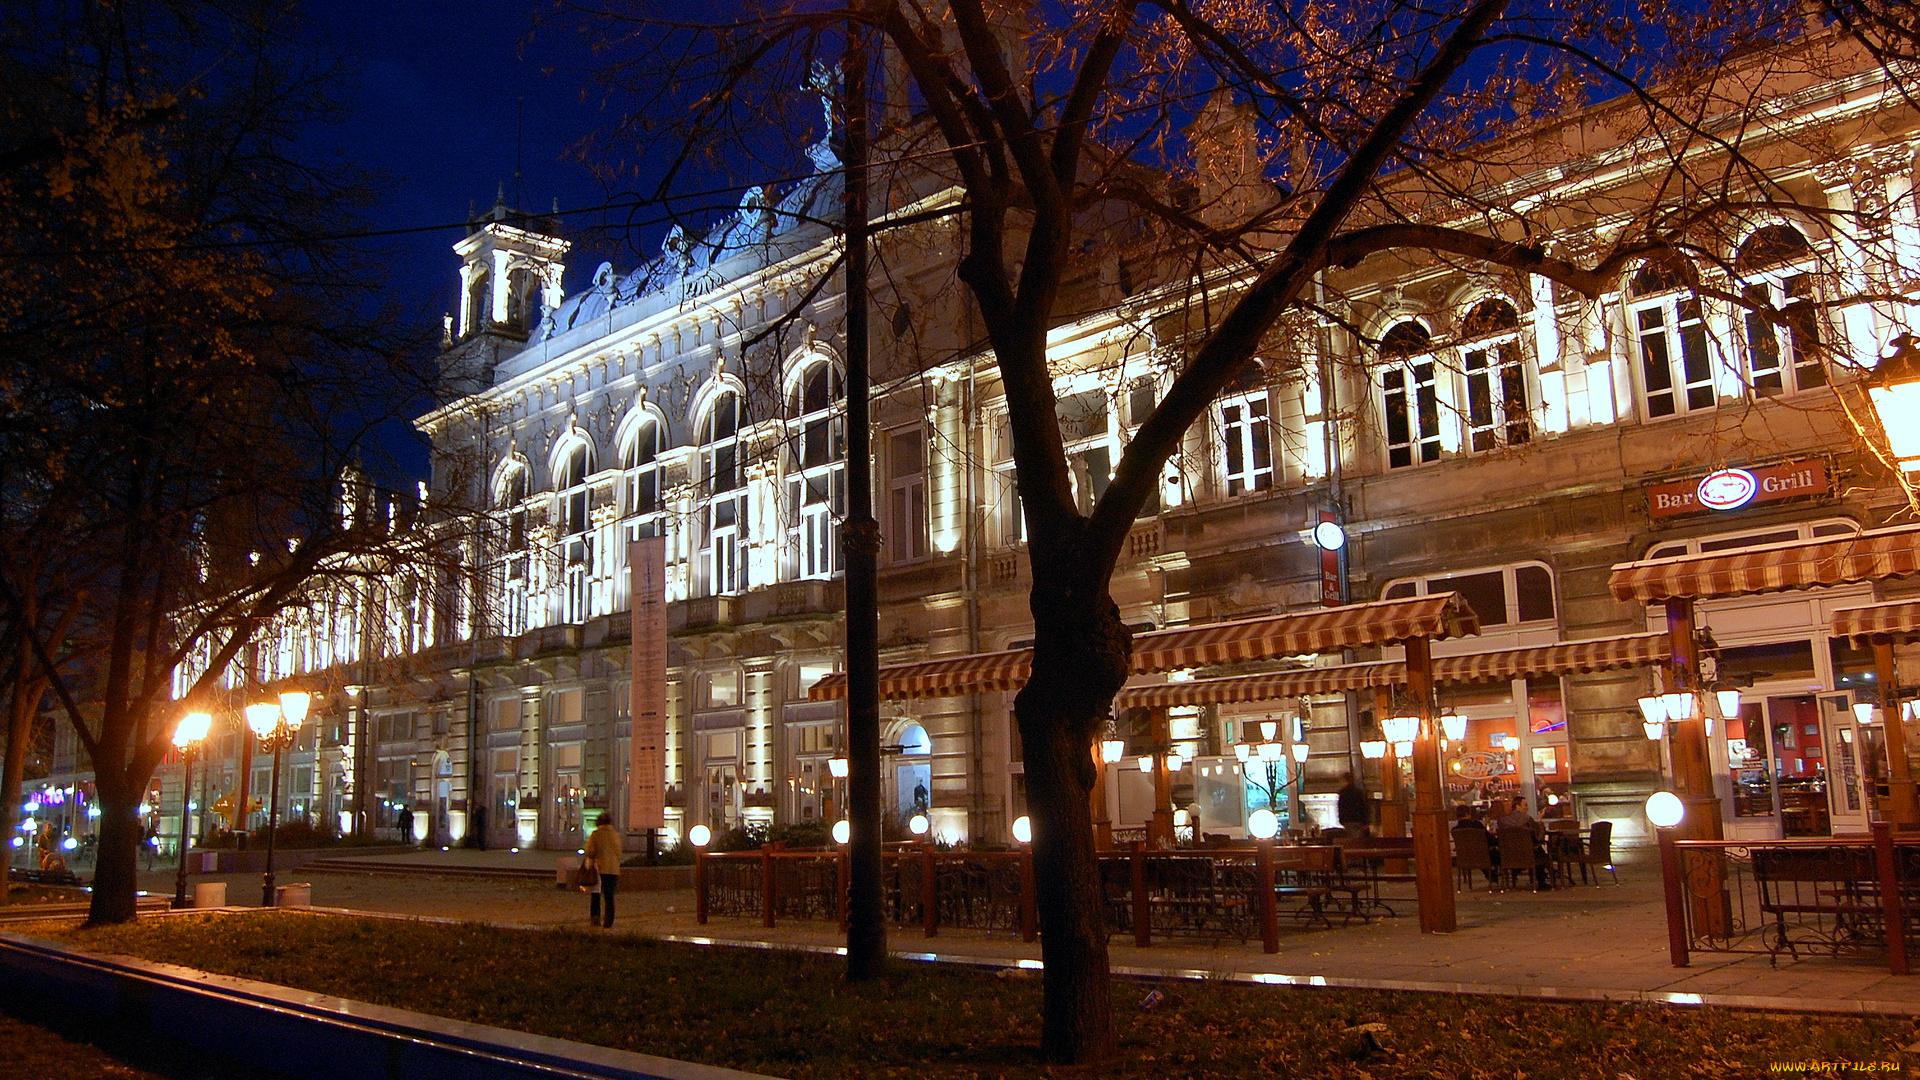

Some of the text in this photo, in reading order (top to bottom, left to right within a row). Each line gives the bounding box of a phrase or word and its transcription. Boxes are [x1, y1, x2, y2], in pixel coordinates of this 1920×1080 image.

[1656, 492, 1694, 509] Bar
[1762, 469, 1814, 493] Grill
[1325, 571, 1337, 581] Bar
[1324, 590, 1339, 601] Grill
[1448, 782, 1470, 792] Bar
